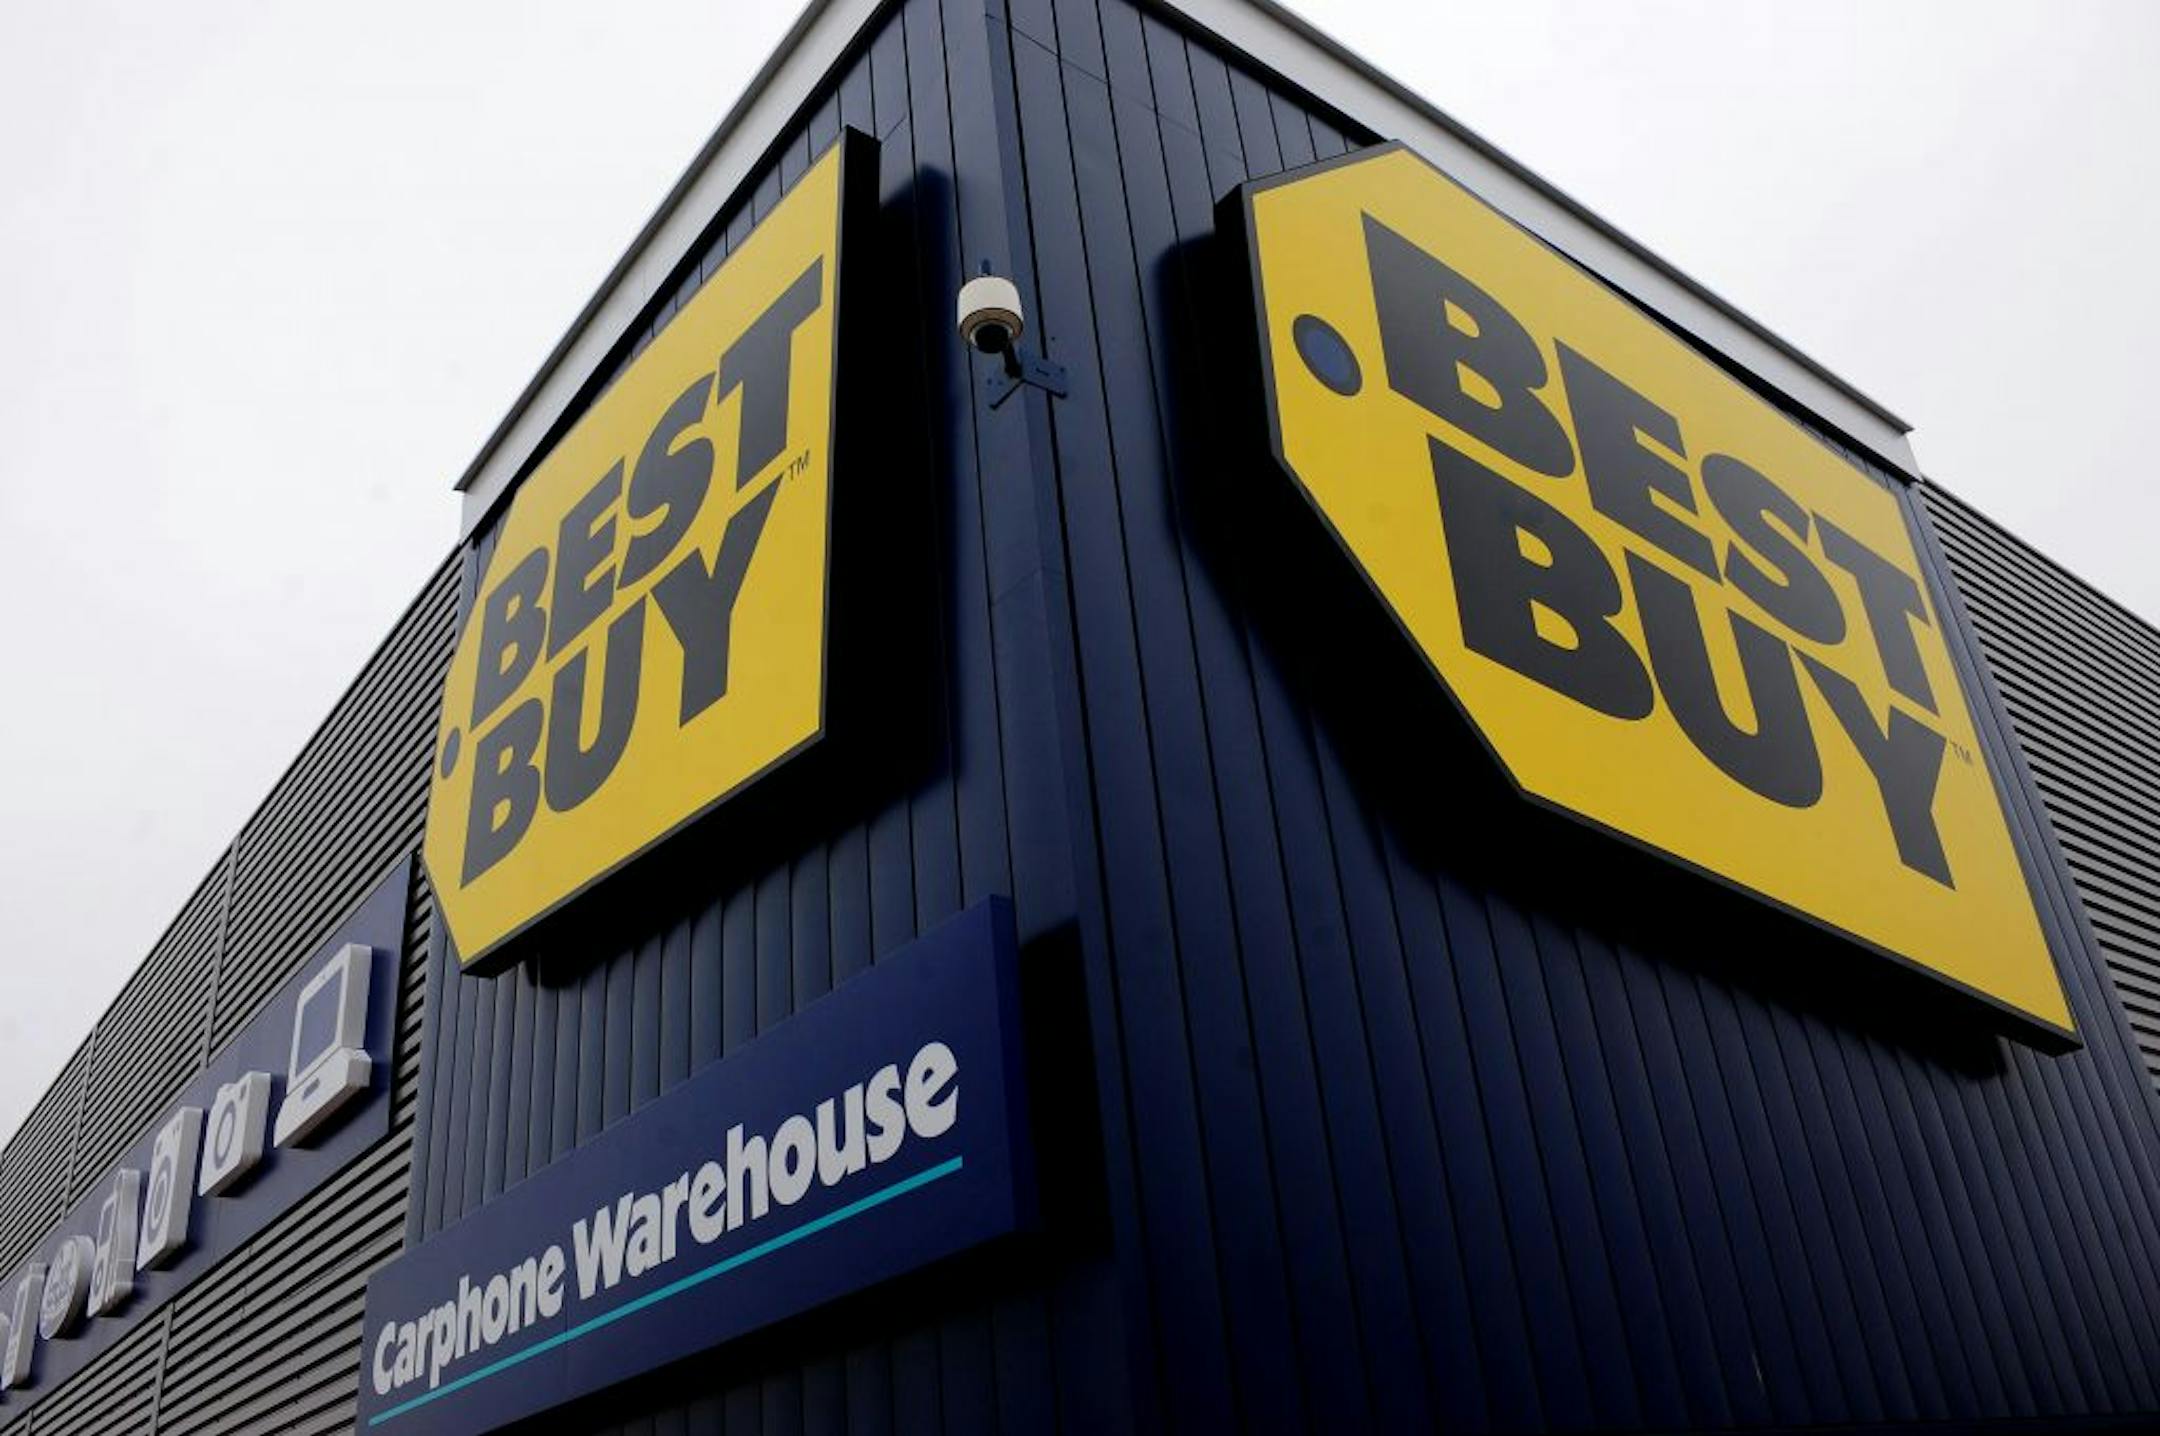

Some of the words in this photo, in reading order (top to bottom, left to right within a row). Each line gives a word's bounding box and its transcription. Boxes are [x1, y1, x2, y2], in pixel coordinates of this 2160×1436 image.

[460, 472, 784, 888] BUY
[469, 255, 824, 732] BEST
[1361, 211, 1941, 717] BEST
[1426, 432, 1956, 890] BUY
[372, 1245, 564, 1395] Carphone
[571, 1041, 959, 1300] Warehouse
